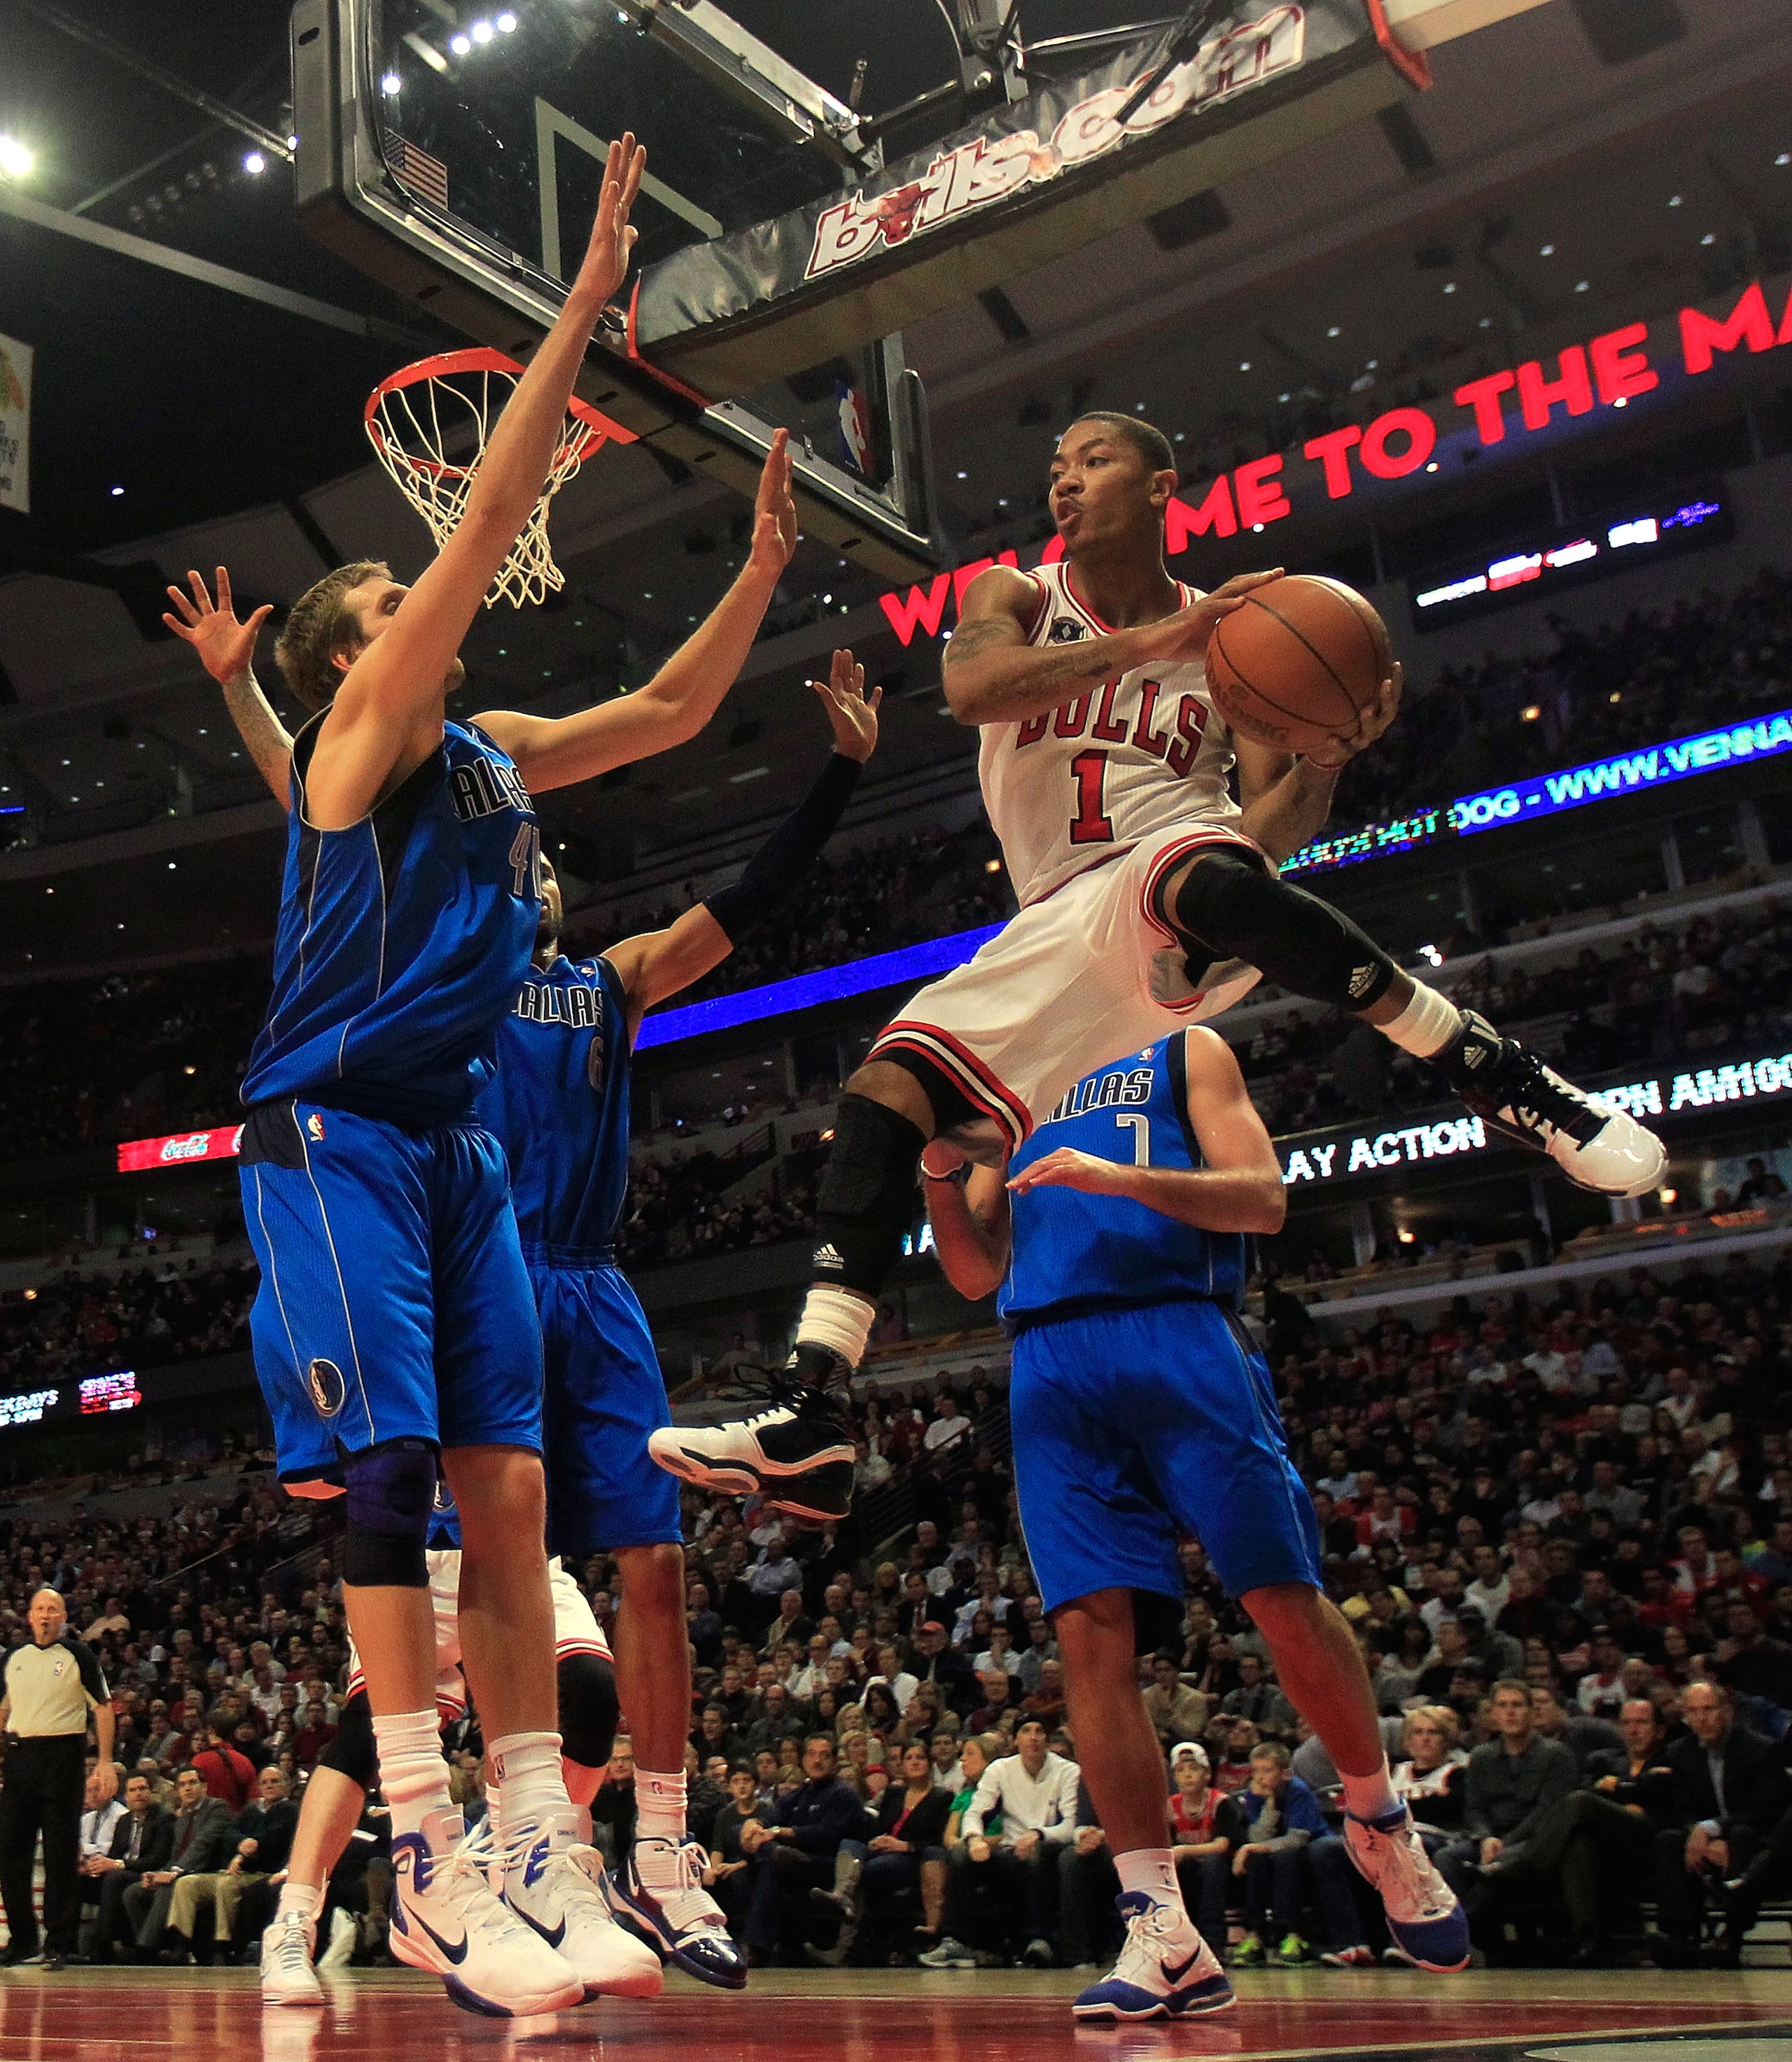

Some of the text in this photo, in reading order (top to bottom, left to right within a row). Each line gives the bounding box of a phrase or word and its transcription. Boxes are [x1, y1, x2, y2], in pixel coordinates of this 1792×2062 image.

[805, 5, 1306, 279] blls.com
[1303, 407, 1436, 499] TO
[1454, 322, 1660, 445] THE
[1679, 282, 1792, 374] M
[1070, 748, 1114, 846] 1
[509, 820, 542, 900] 41
[512, 981, 604, 1029] ALLAS
[1042, 1068, 1154, 1125] LLAS
[1116, 1114, 1149, 1167] 7
[1348, 1116, 1488, 1173] ACTION
